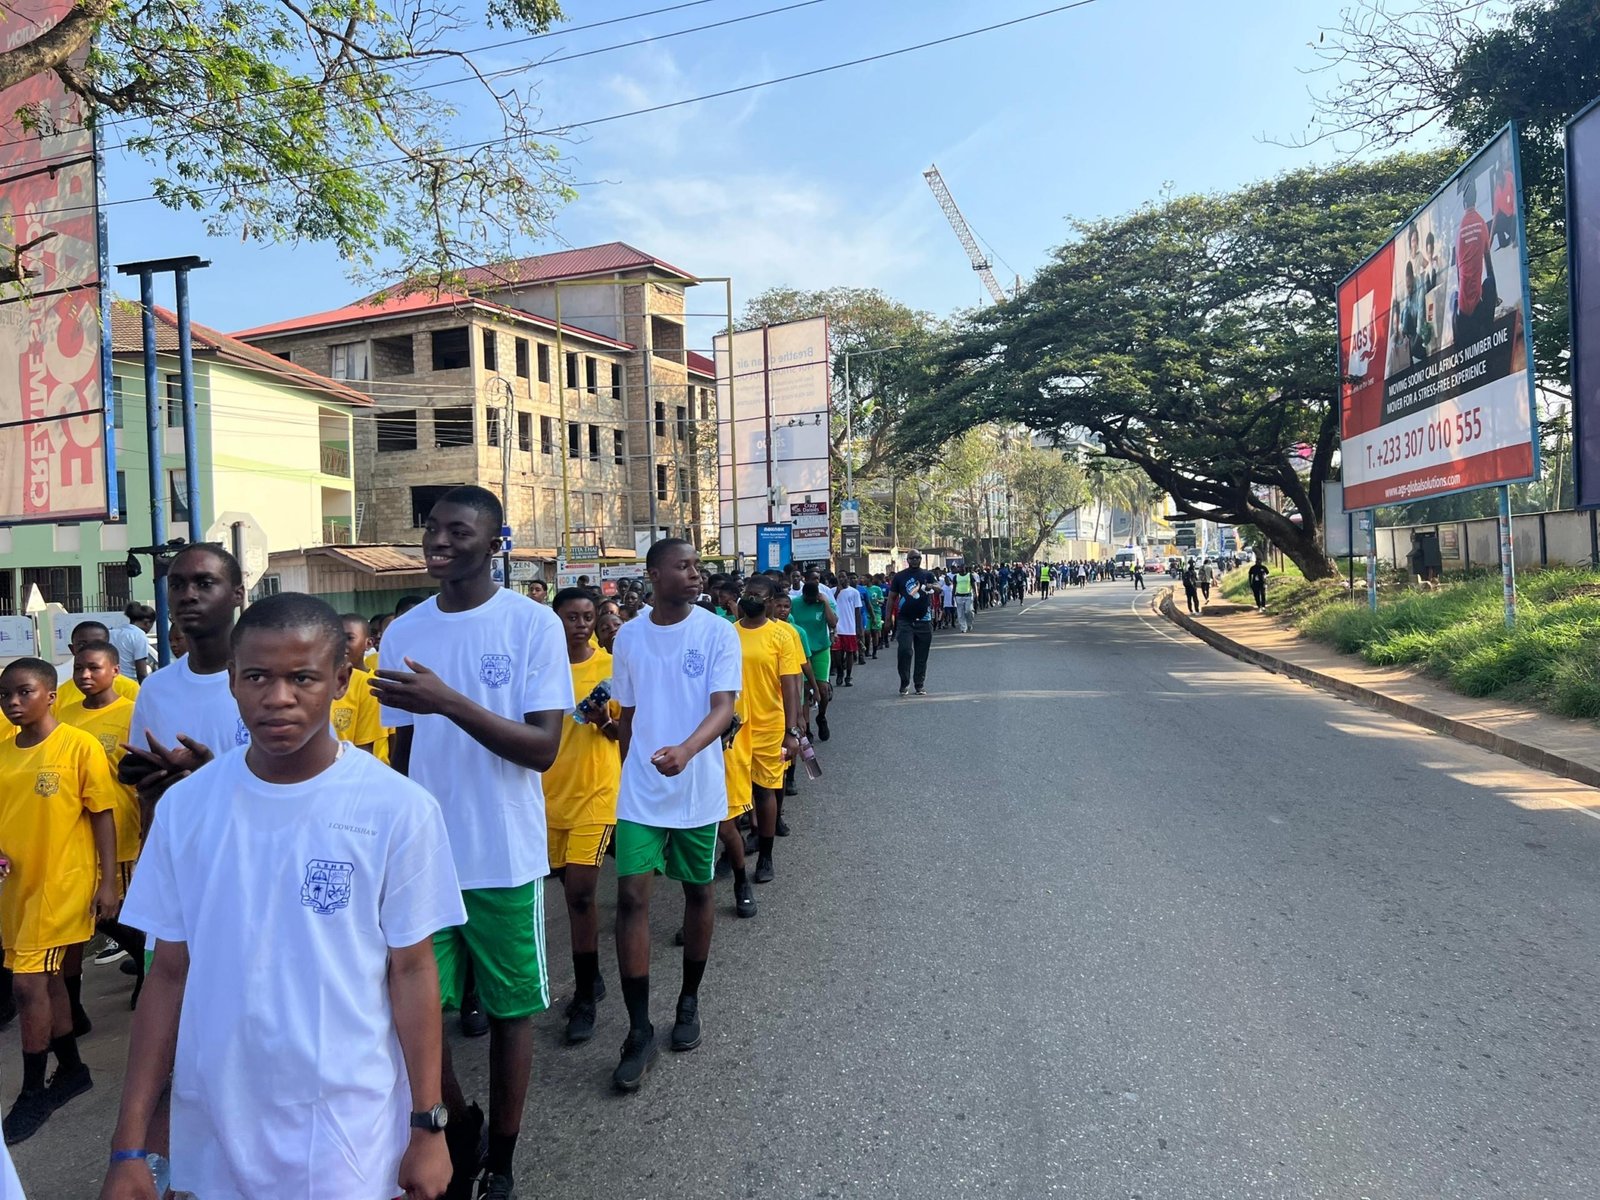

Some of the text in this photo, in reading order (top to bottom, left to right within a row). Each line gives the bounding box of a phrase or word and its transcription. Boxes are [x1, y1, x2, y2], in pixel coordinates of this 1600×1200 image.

[1352, 326, 1368, 355] AGS
[1388, 327, 1508, 397] MOVING SOON? CALL AFRICA'S NUMBER ONE
[1386, 397, 1403, 414] MOVER
[1403, 393, 1414, 407] FOR
[1418, 377, 1450, 401] STRESS-FREE
[1451, 360, 1487, 388] EXPERIENCE
[1366, 407, 1482, 469] T. +233 307 010 555
[1384, 474, 1461, 498] www.ags-globalsolutions.com
